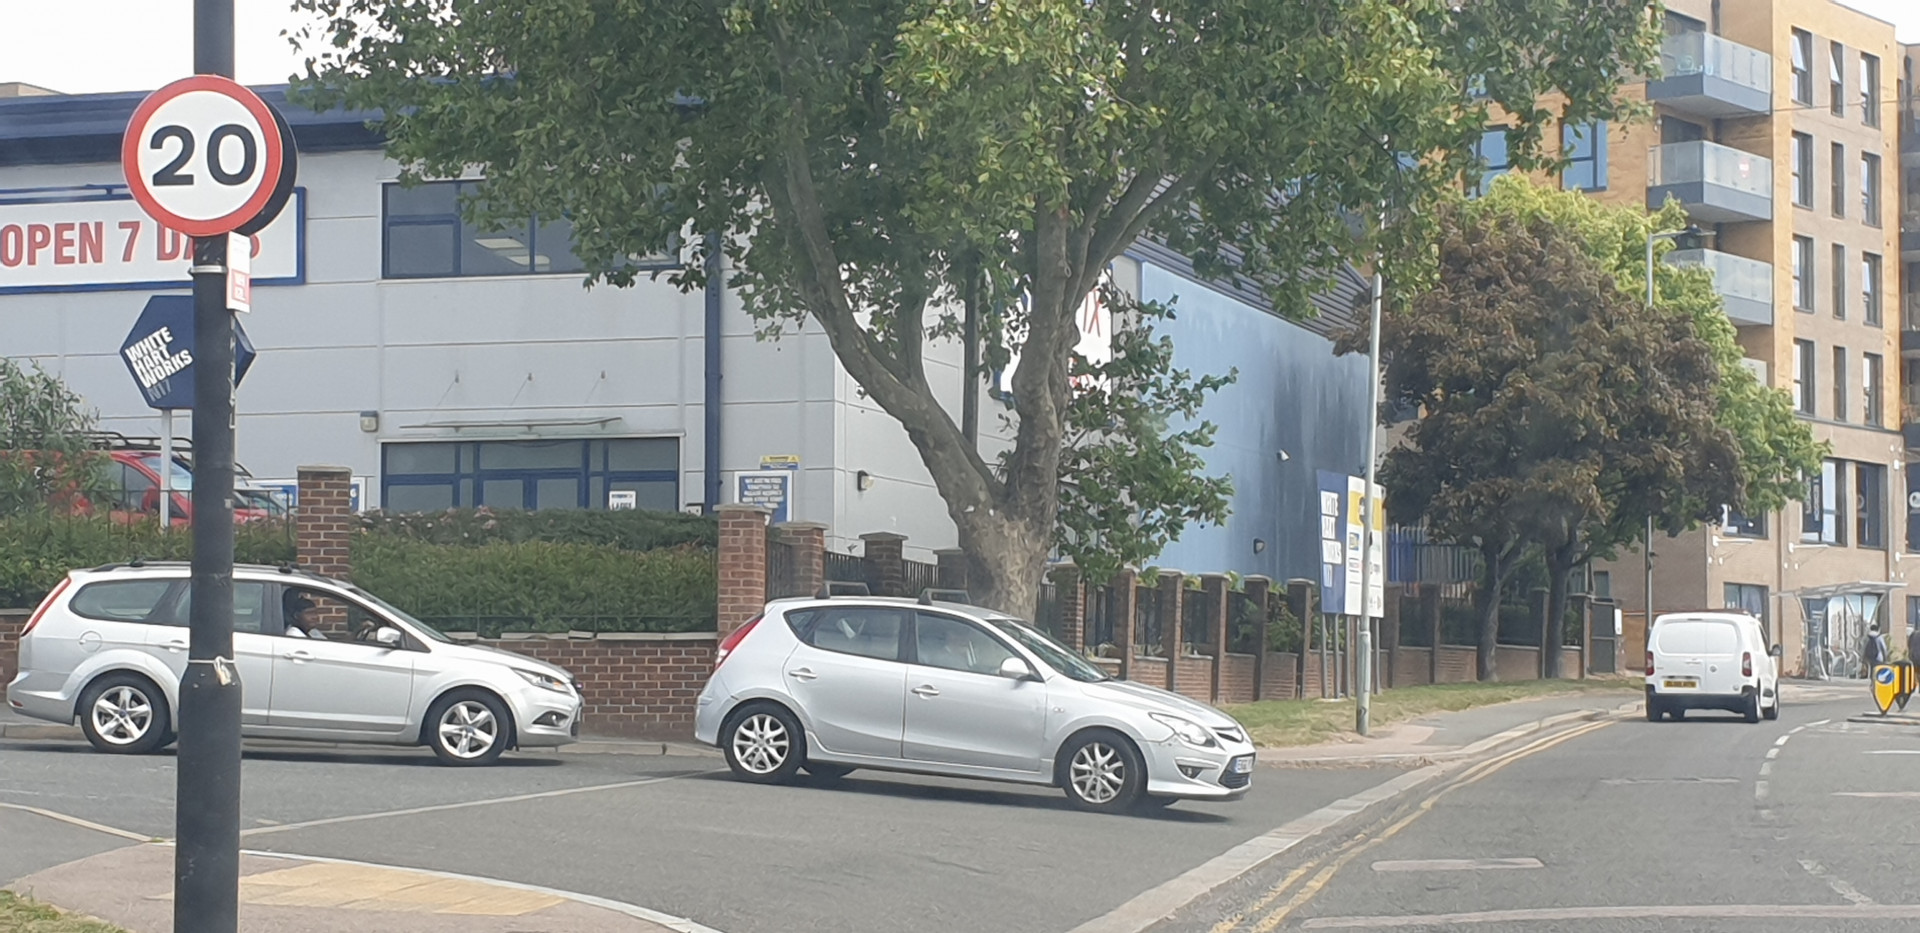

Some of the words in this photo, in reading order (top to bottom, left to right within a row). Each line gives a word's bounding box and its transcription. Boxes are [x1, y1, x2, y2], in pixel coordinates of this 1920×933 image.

[150, 124, 257, 186] 20
[0, 221, 103, 267] OPEN
[118, 221, 141, 263] 7
[125, 326, 174, 362] WHITE
[132, 345, 171, 378] HART
[139, 349, 193, 388] WORKS
